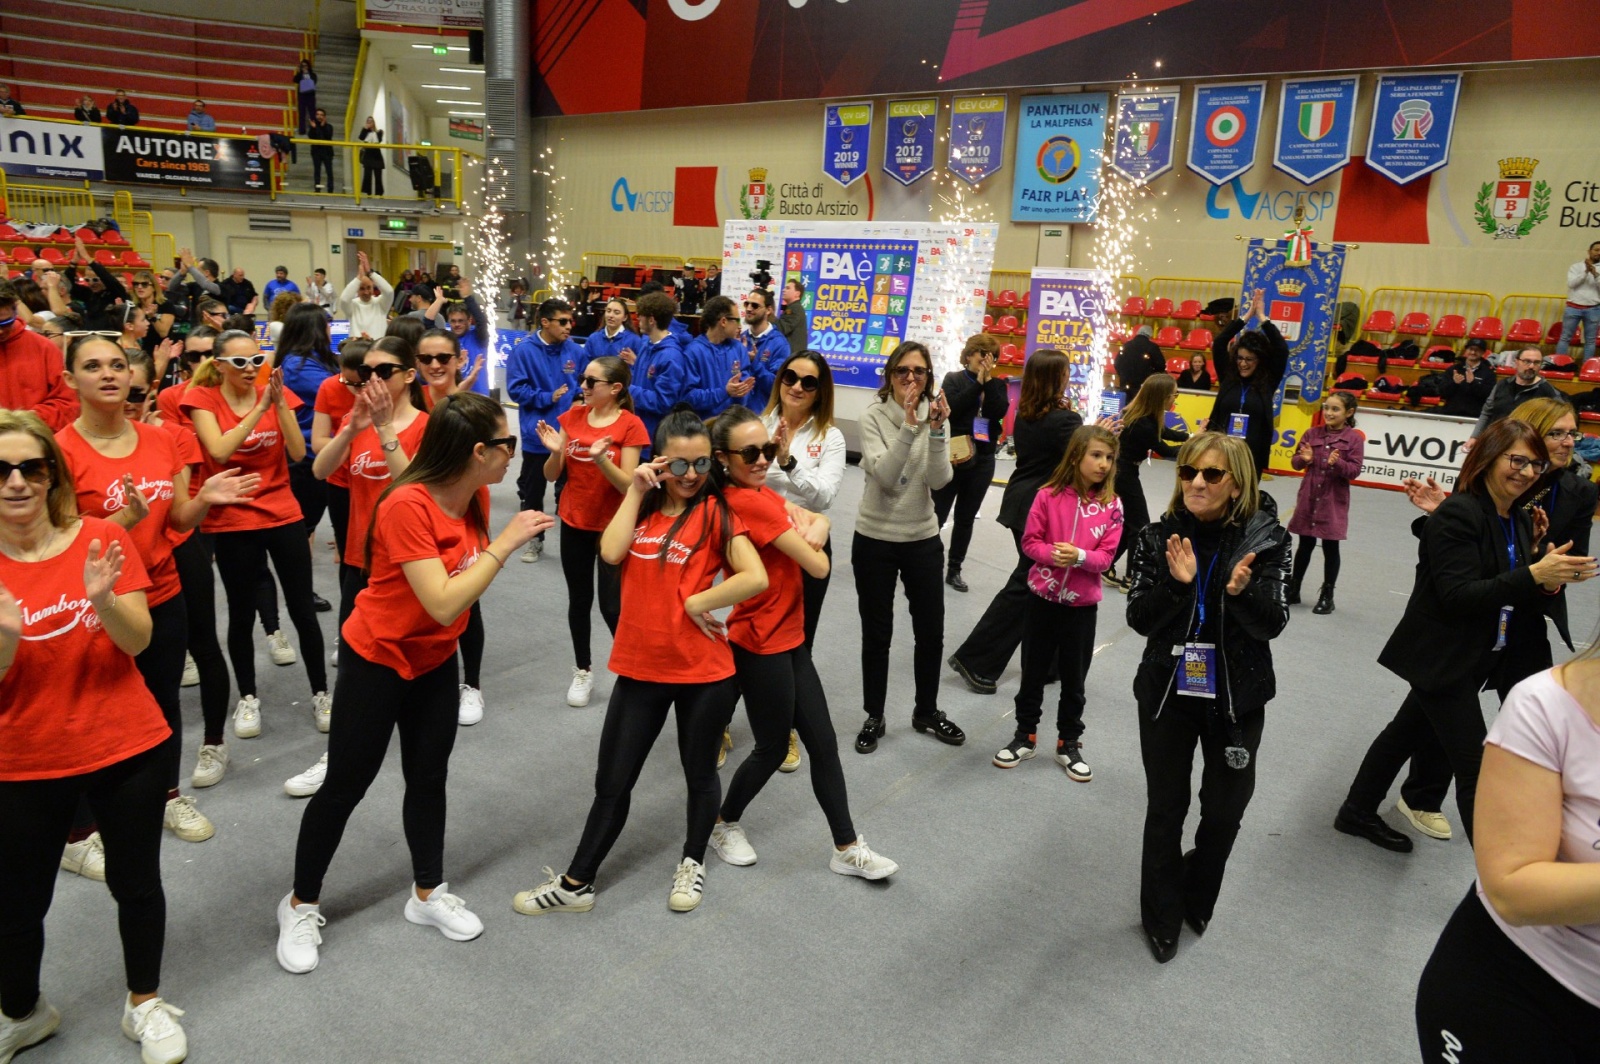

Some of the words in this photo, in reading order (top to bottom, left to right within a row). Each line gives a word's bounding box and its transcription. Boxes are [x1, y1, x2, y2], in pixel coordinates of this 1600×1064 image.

[894, 105, 909, 114] CEV
[911, 104, 930, 112] CUP
[959, 101, 977, 110] CEV
[980, 100, 998, 108] CUP
[1027, 103, 1100, 116] PANATHLON
[1031, 120, 1041, 128] LA
[1045, 118, 1093, 128] MALPENSA
[116, 135, 229, 161] AUTOREX
[895, 145, 923, 156] 2012
[961, 146, 990, 156] 2010
[834, 151, 859, 162] 2019
[961, 156, 988, 164] WINNER
[136, 158, 158, 168] Cars
[160, 160, 186, 171] since
[187, 162, 210, 172] 1963
[754, 186, 760, 194] B
[780, 182, 808, 198] Città
[812, 183, 823, 198] di
[1021, 189, 1052, 202] FAIR
[1056, 189, 1088, 202] PLAY
[1506, 184, 1520, 196] B
[1565, 181, 1600, 202] Cit
[636, 191, 674, 212] AGESP
[753, 196, 760, 204] B
[1256, 190, 1335, 222] AGESP
[1504, 200, 1517, 211] B
[780, 200, 813, 215] Busto
[816, 200, 858, 216] Arsizio
[1560, 206, 1600, 228] Bus
[817, 281, 868, 302] CITTÀ
[815, 300, 867, 313] EUROPEA
[1282, 306, 1291, 318] B
[812, 316, 866, 333] SPORT
[1038, 318, 1094, 335] CITTÀ
[807, 331, 863, 353] 2023
[1036, 334, 1093, 346] EUROPEA
[1356, 429, 1467, 463] -wor
[1360, 464, 1395, 477] enzia
[1400, 469, 1424, 480] per
[1429, 471, 1437, 480] il
[666, 552, 688, 564] Club
